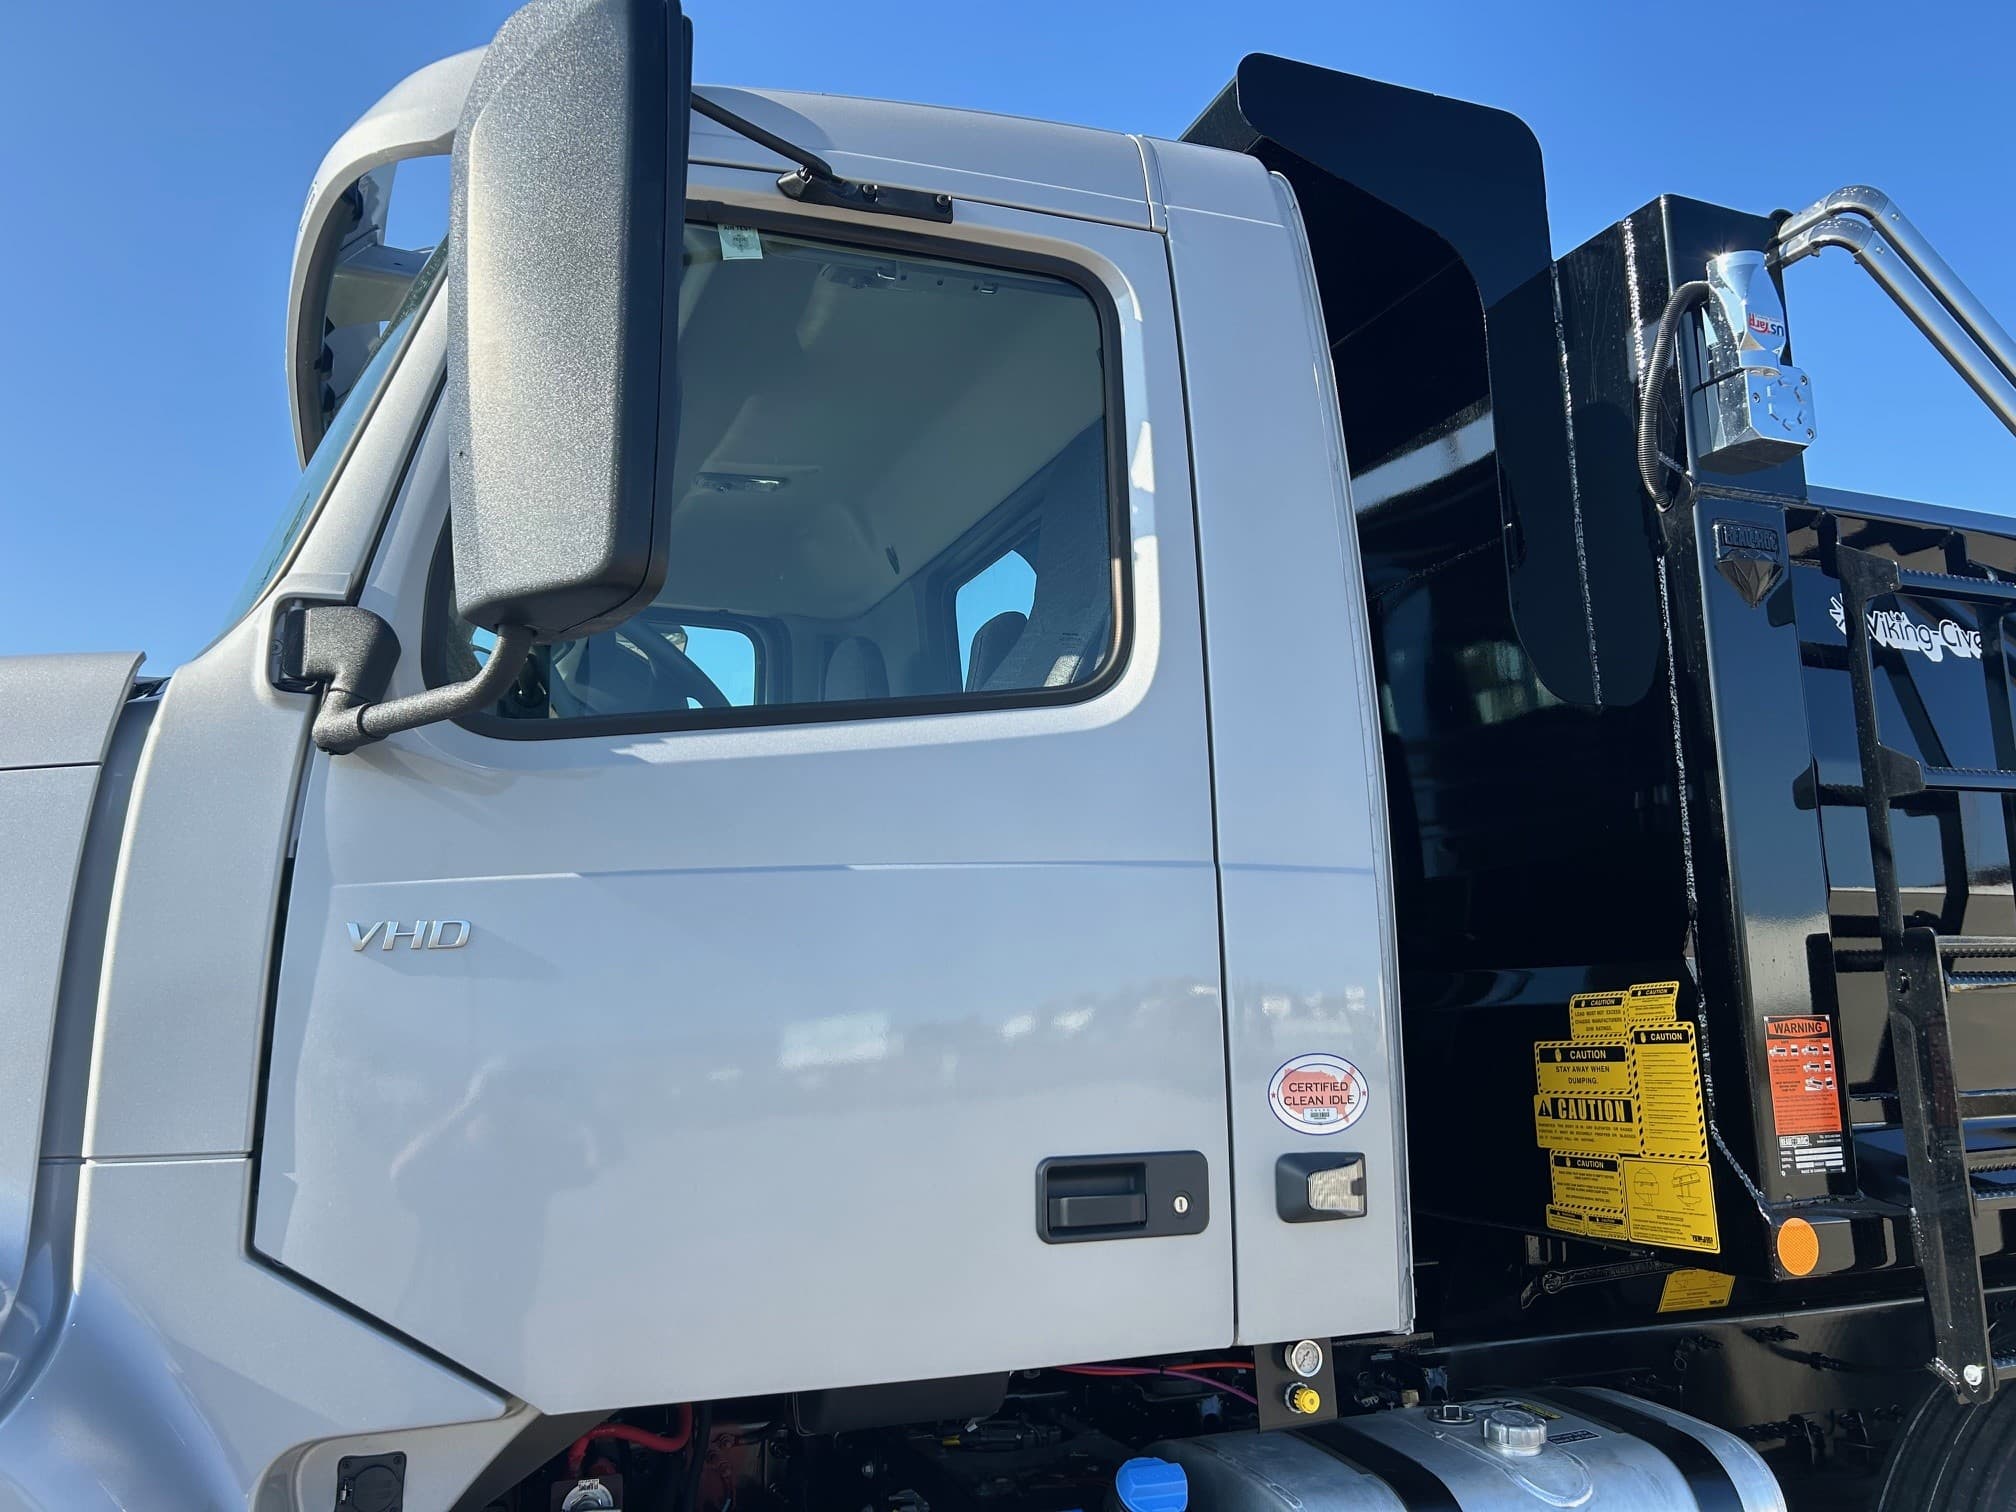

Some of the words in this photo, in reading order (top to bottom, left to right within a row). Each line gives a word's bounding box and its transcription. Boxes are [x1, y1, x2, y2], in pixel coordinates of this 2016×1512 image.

[346, 919, 472, 951] VHD
[1590, 998, 1616, 1007] CAUTION
[1774, 1022, 1823, 1035] WARNING
[1650, 1032, 1683, 1042] CAUTION
[1569, 1049, 1607, 1060] CAUTION
[1555, 1065, 1570, 1073] STAY
[1571, 1065, 1589, 1073] AWAY
[1590, 1065, 1610, 1073] WHEN
[1288, 1081, 1349, 1093] CERTIFIED
[1283, 1096, 1324, 1106] CLEAN
[1329, 1094, 1355, 1105] IDLE
[1557, 1098, 1626, 1122] CAUTION
[1577, 1159, 1604, 1169] CAUTION
